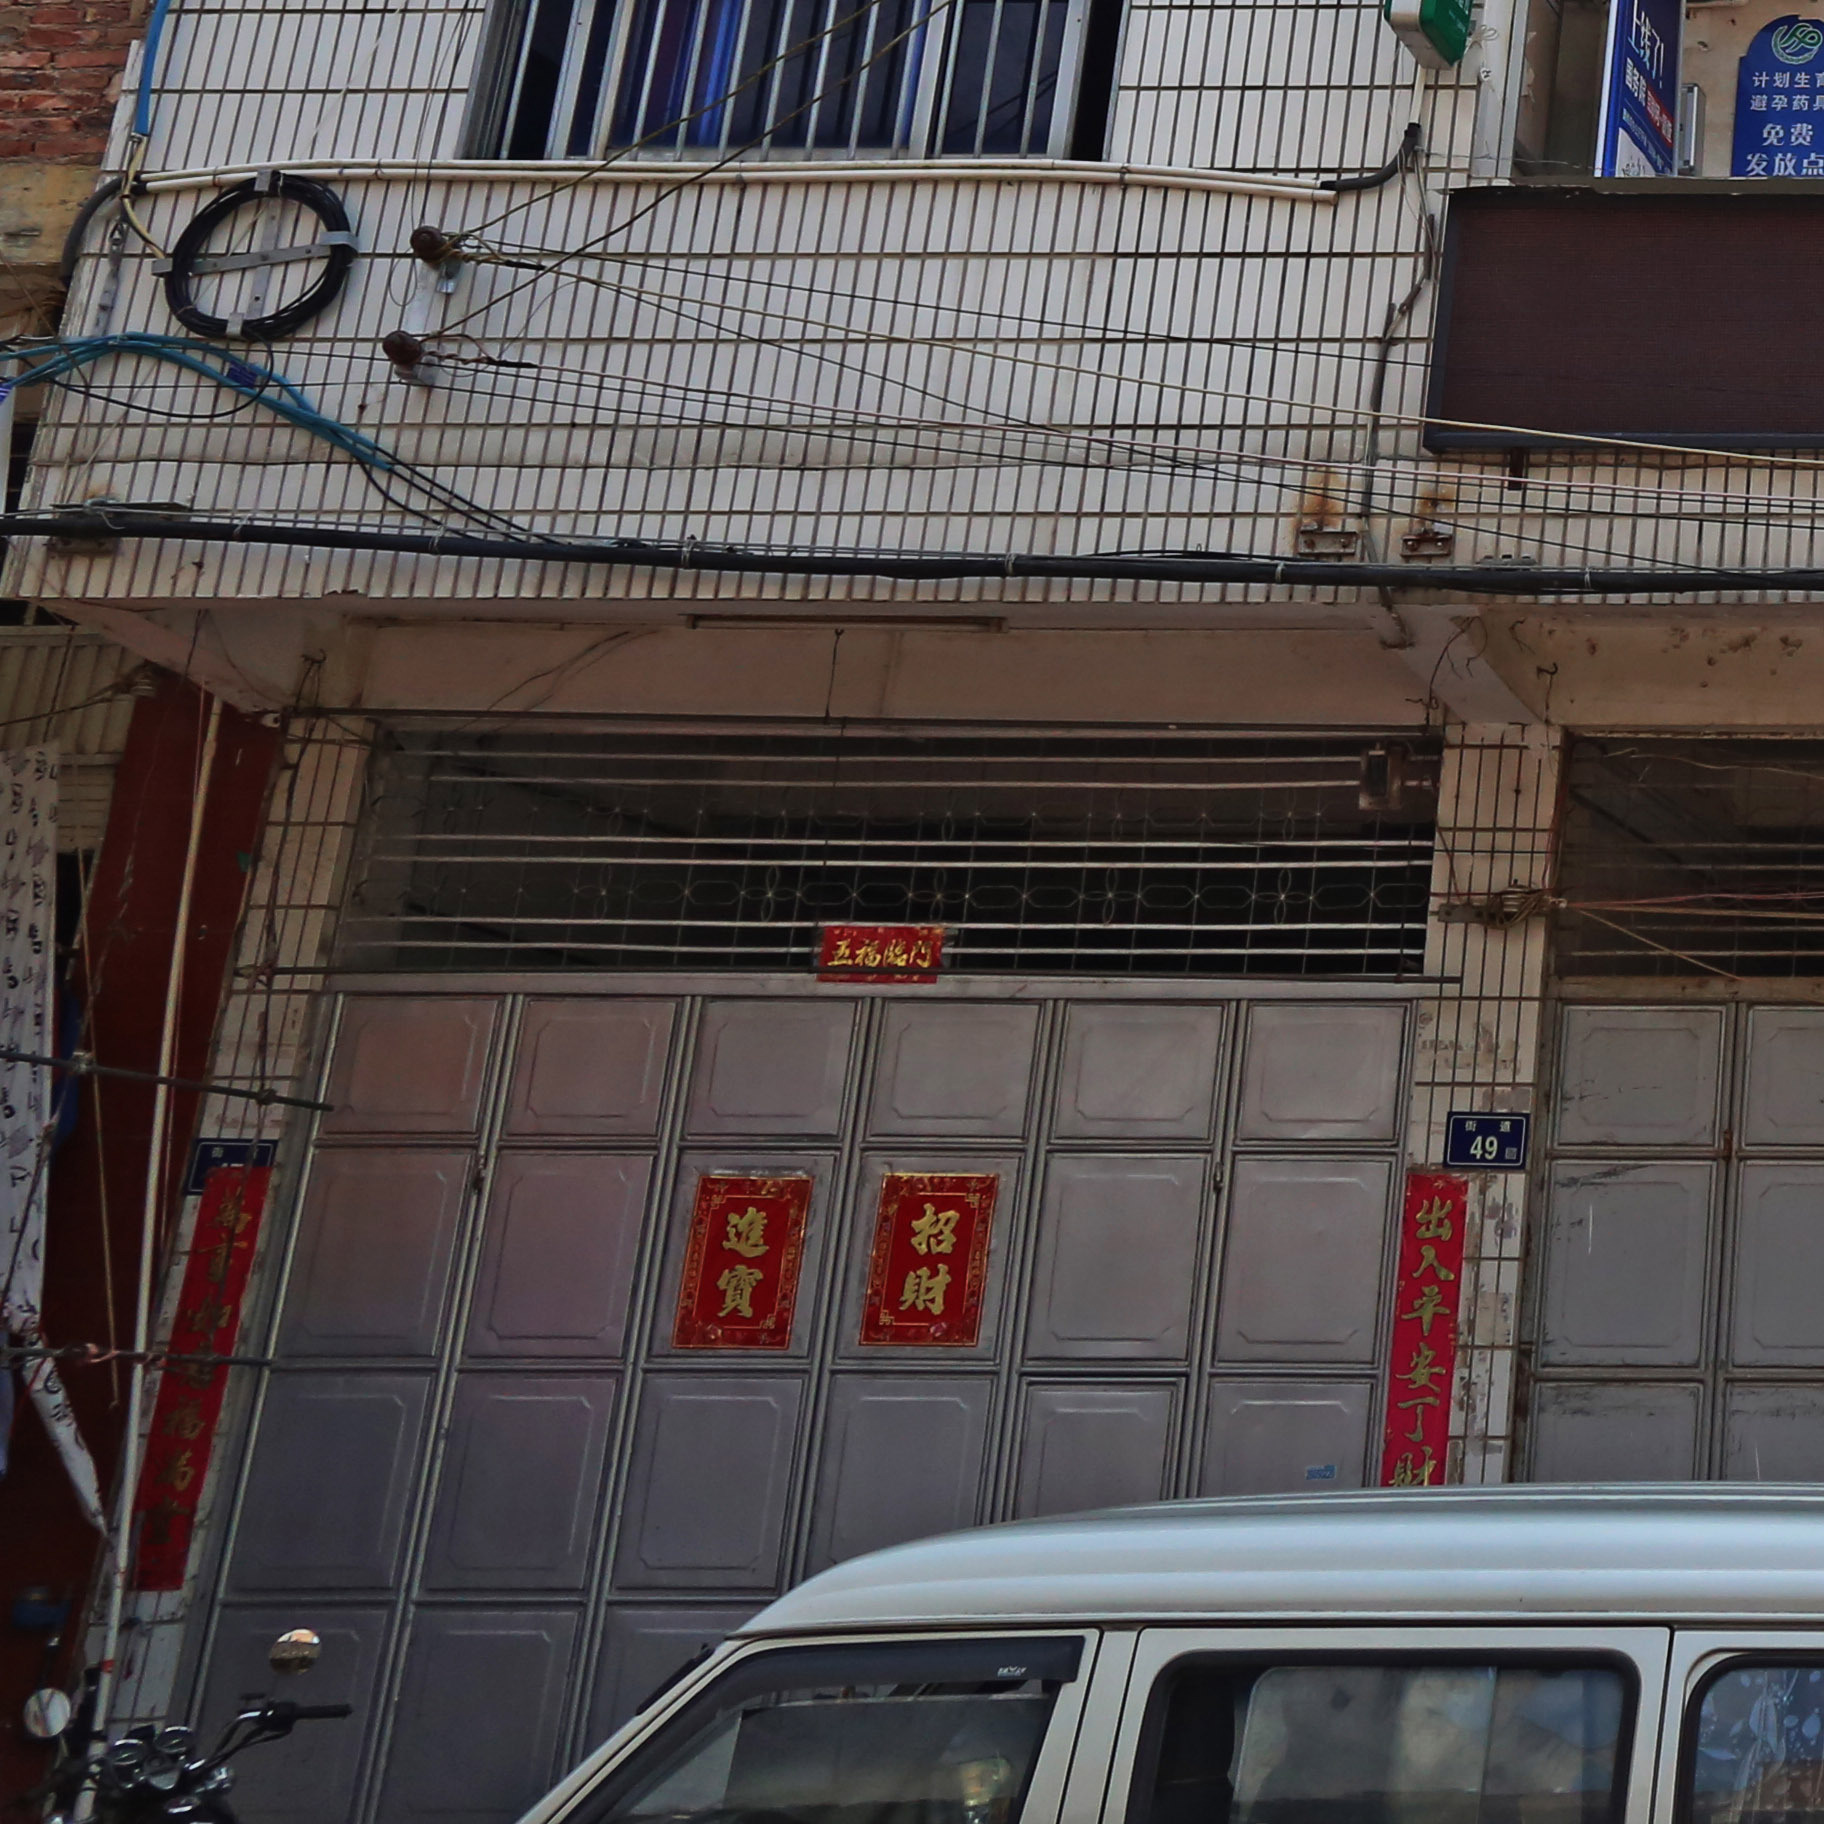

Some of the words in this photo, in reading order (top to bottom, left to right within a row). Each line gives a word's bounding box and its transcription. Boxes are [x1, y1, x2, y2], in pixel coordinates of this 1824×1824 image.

[1762, 123, 1814, 146] 免费
[1745, 152, 1824, 176] 发放点
[1469, 1135, 1499, 1161] 49
[716, 1206, 769, 1318] 進寶
[898, 1202, 960, 1316] 招財
